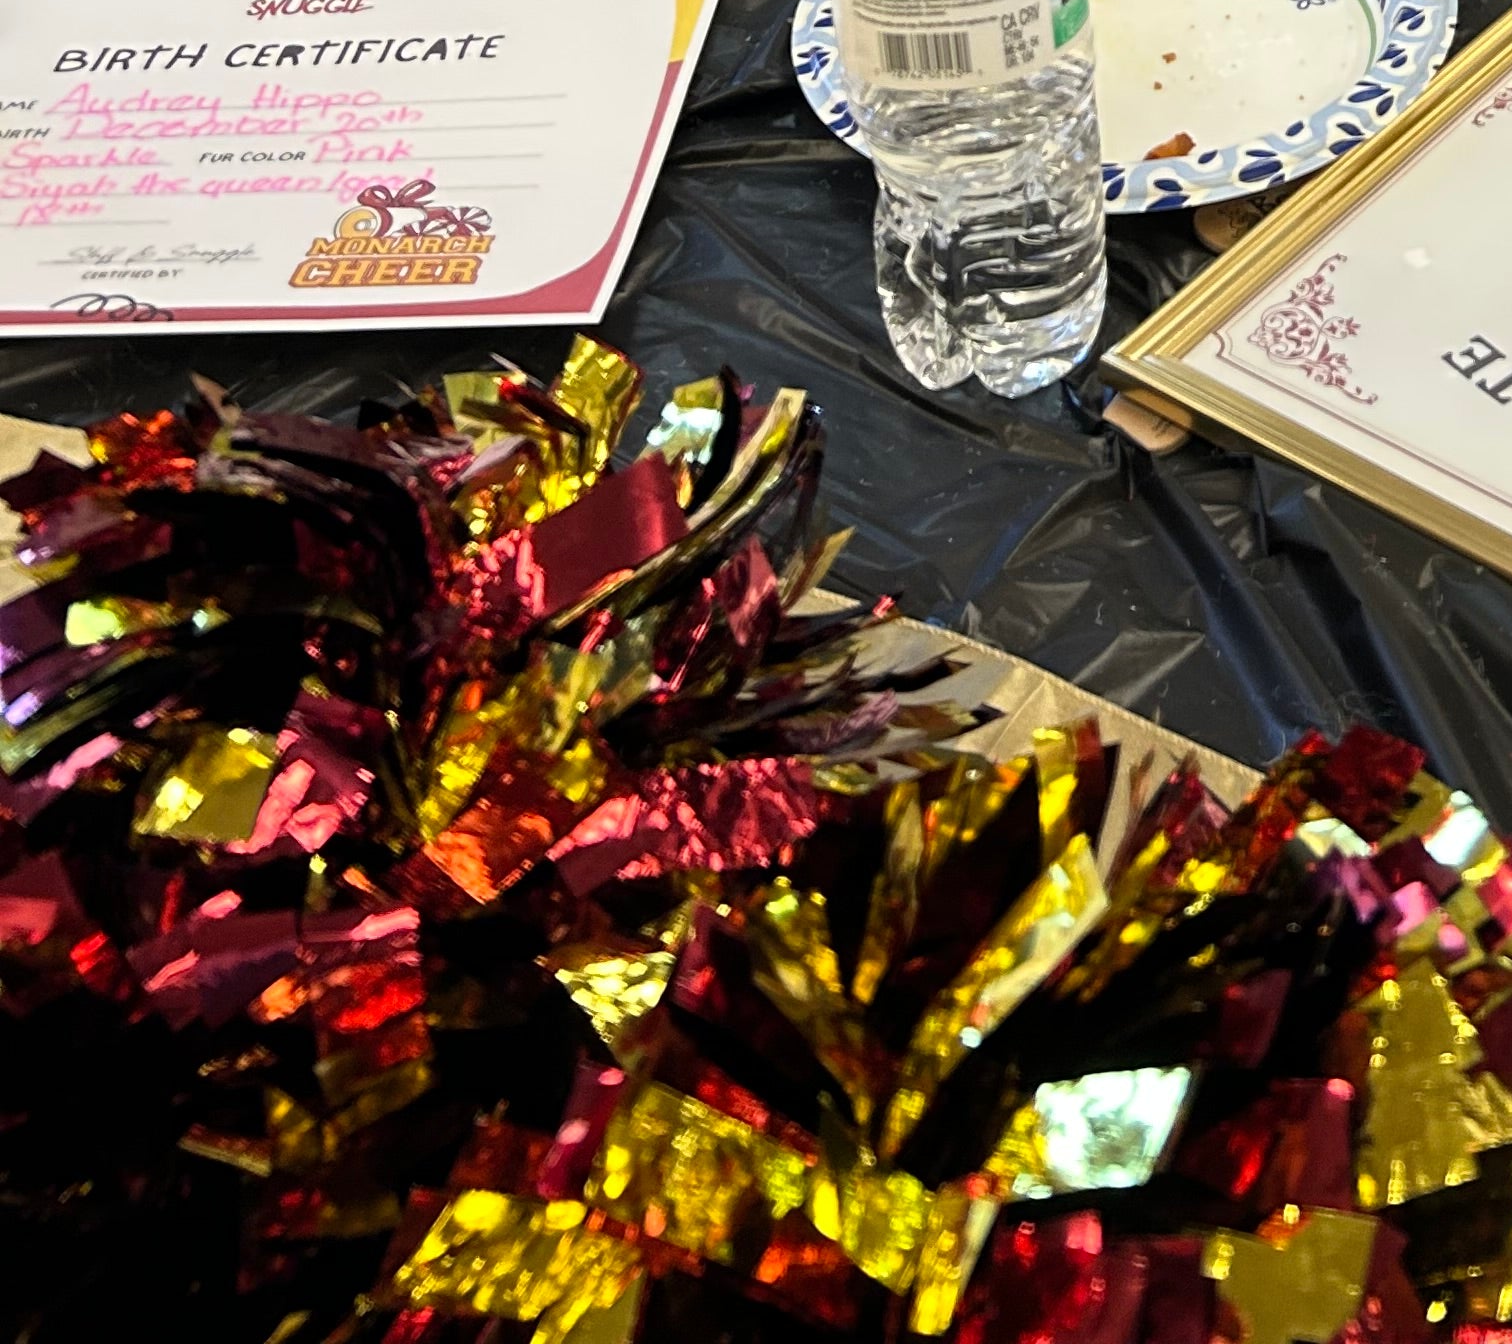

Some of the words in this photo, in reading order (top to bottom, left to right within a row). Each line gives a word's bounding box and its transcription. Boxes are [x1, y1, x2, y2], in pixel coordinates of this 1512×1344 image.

[53, 43, 208, 74] BIRTH
[224, 34, 506, 69] CERTIFICATE
[45, 82, 221, 120] Audrey
[252, 83, 382, 121] Hippo
[0, 127, 51, 140] IRTH
[60, 109, 312, 141] December
[332, 105, 425, 134] 20th
[1, 141, 159, 176] Sparkle
[199, 152, 235, 164] FUR
[240, 150, 307, 164] COLOR
[311, 132, 413, 166] Pink
[131, 171, 191, 198] the
[305, 234, 496, 257] MONARCH
[81, 269, 155, 281] CERTIFIED
[288, 255, 483, 289] CHEER
